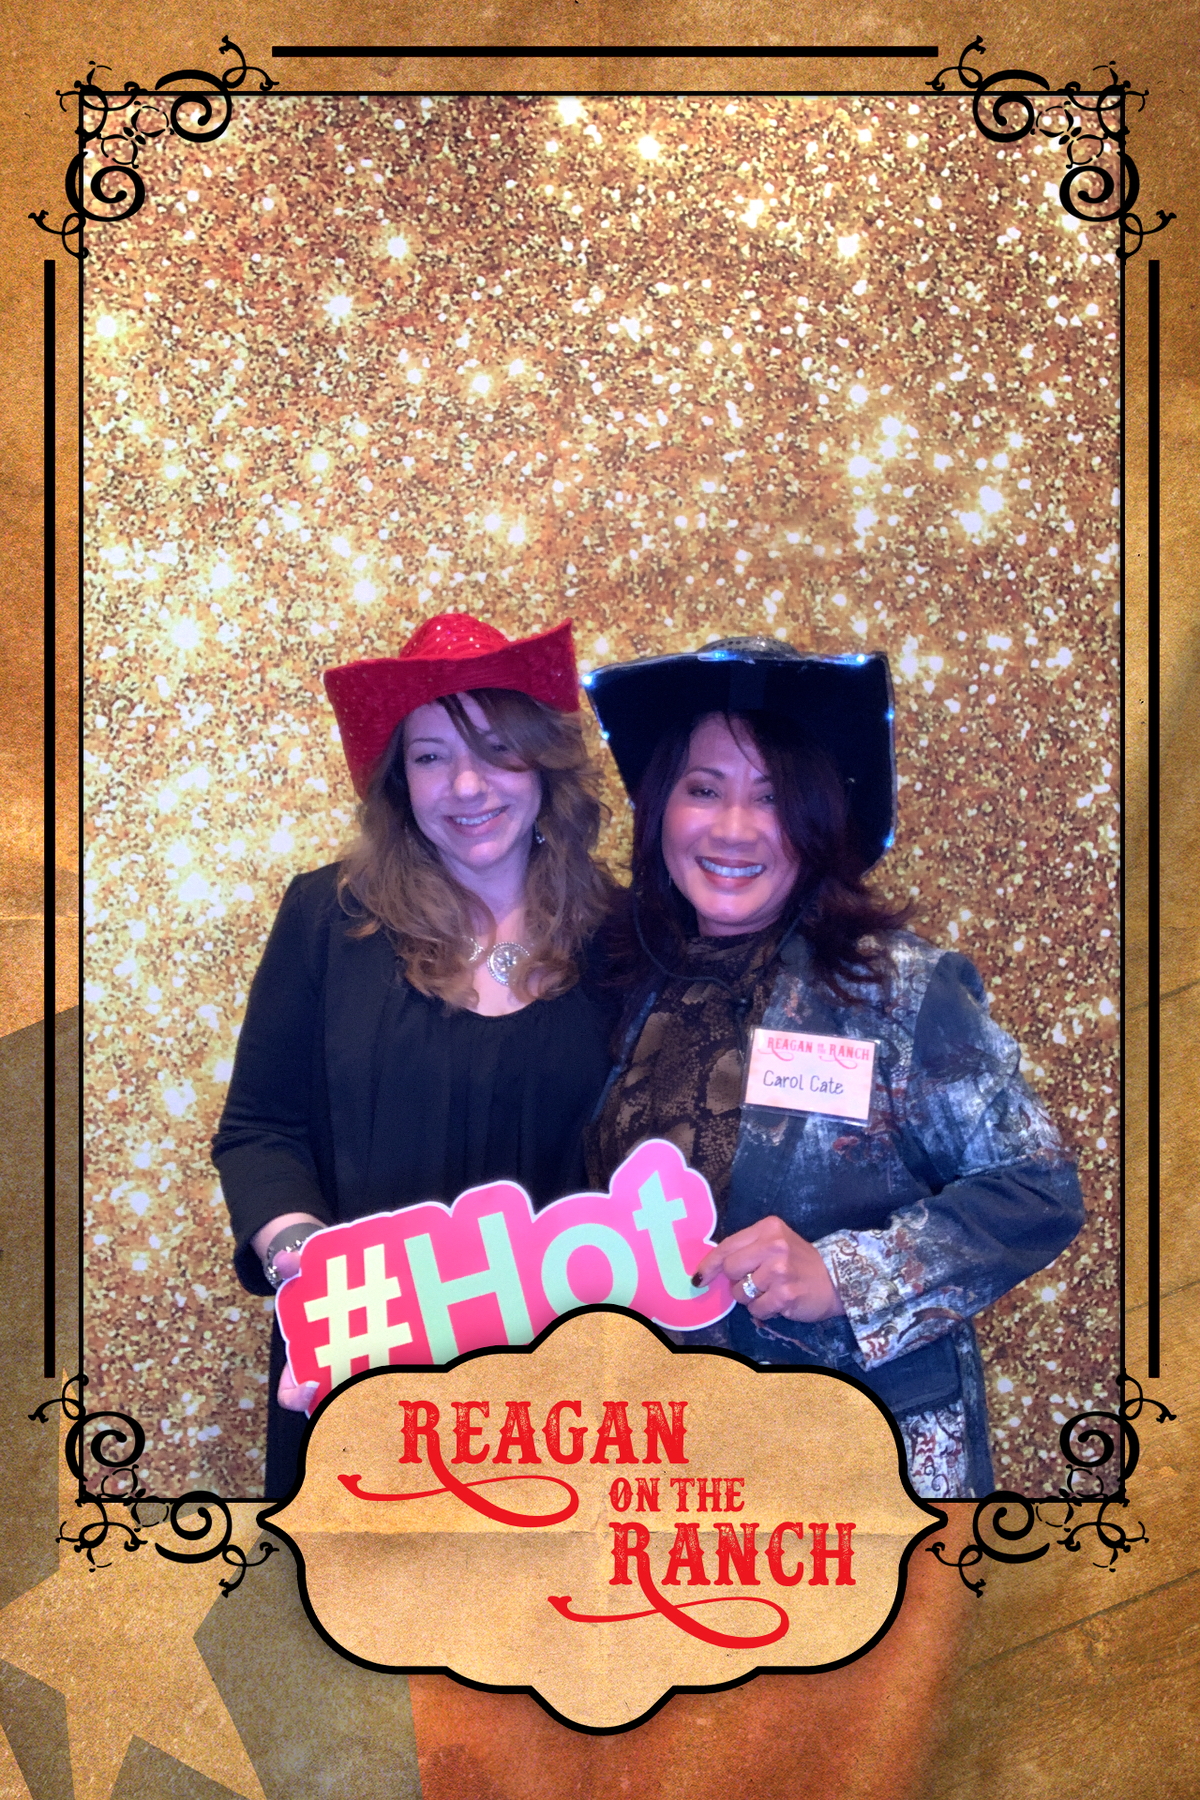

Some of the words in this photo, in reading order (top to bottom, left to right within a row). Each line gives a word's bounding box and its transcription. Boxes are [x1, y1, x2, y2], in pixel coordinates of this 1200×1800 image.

[757, 1037, 813, 1062] REAGAN
[819, 1043, 870, 1070] RANCH
[763, 1070, 804, 1090] Carol
[810, 1075, 844, 1095] Cate
[303, 1170, 709, 1389] #Hot
